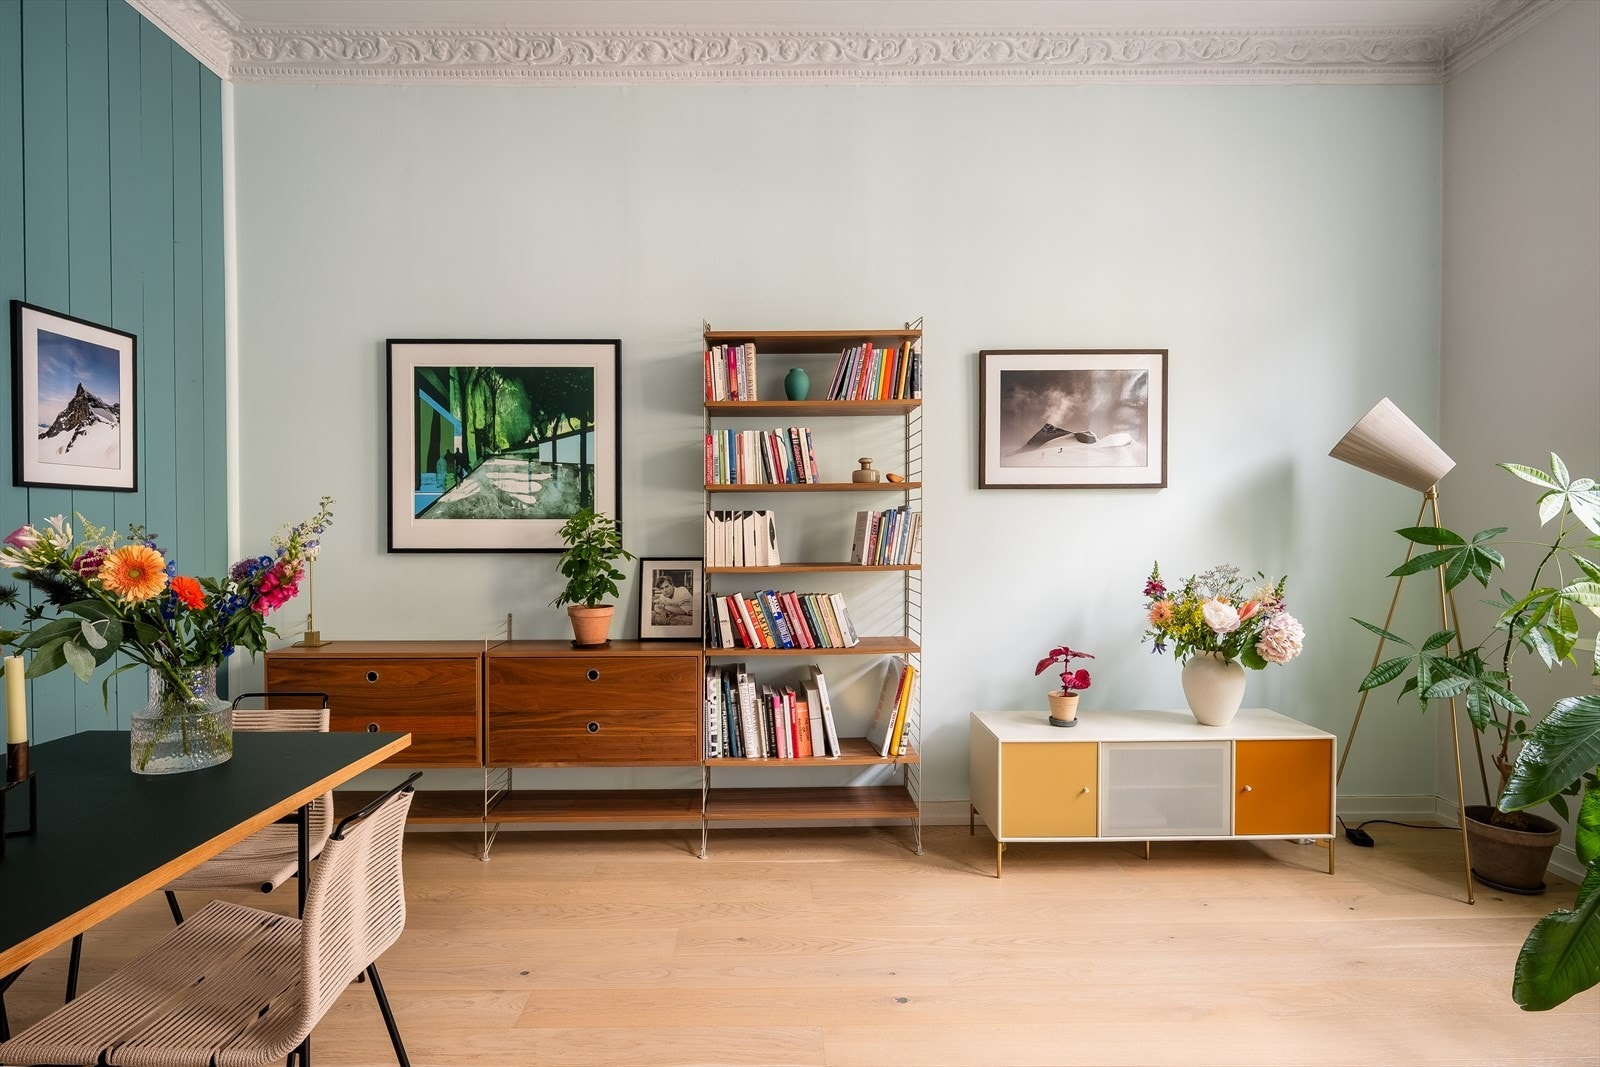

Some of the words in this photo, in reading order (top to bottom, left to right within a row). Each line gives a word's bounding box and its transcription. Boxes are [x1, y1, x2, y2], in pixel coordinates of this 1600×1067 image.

[793, 444, 805, 478] CORRECTIONS
[767, 594, 778, 616] ROONEY
[772, 596, 781, 612] SALLY
[752, 602, 772, 638] PAMUK
